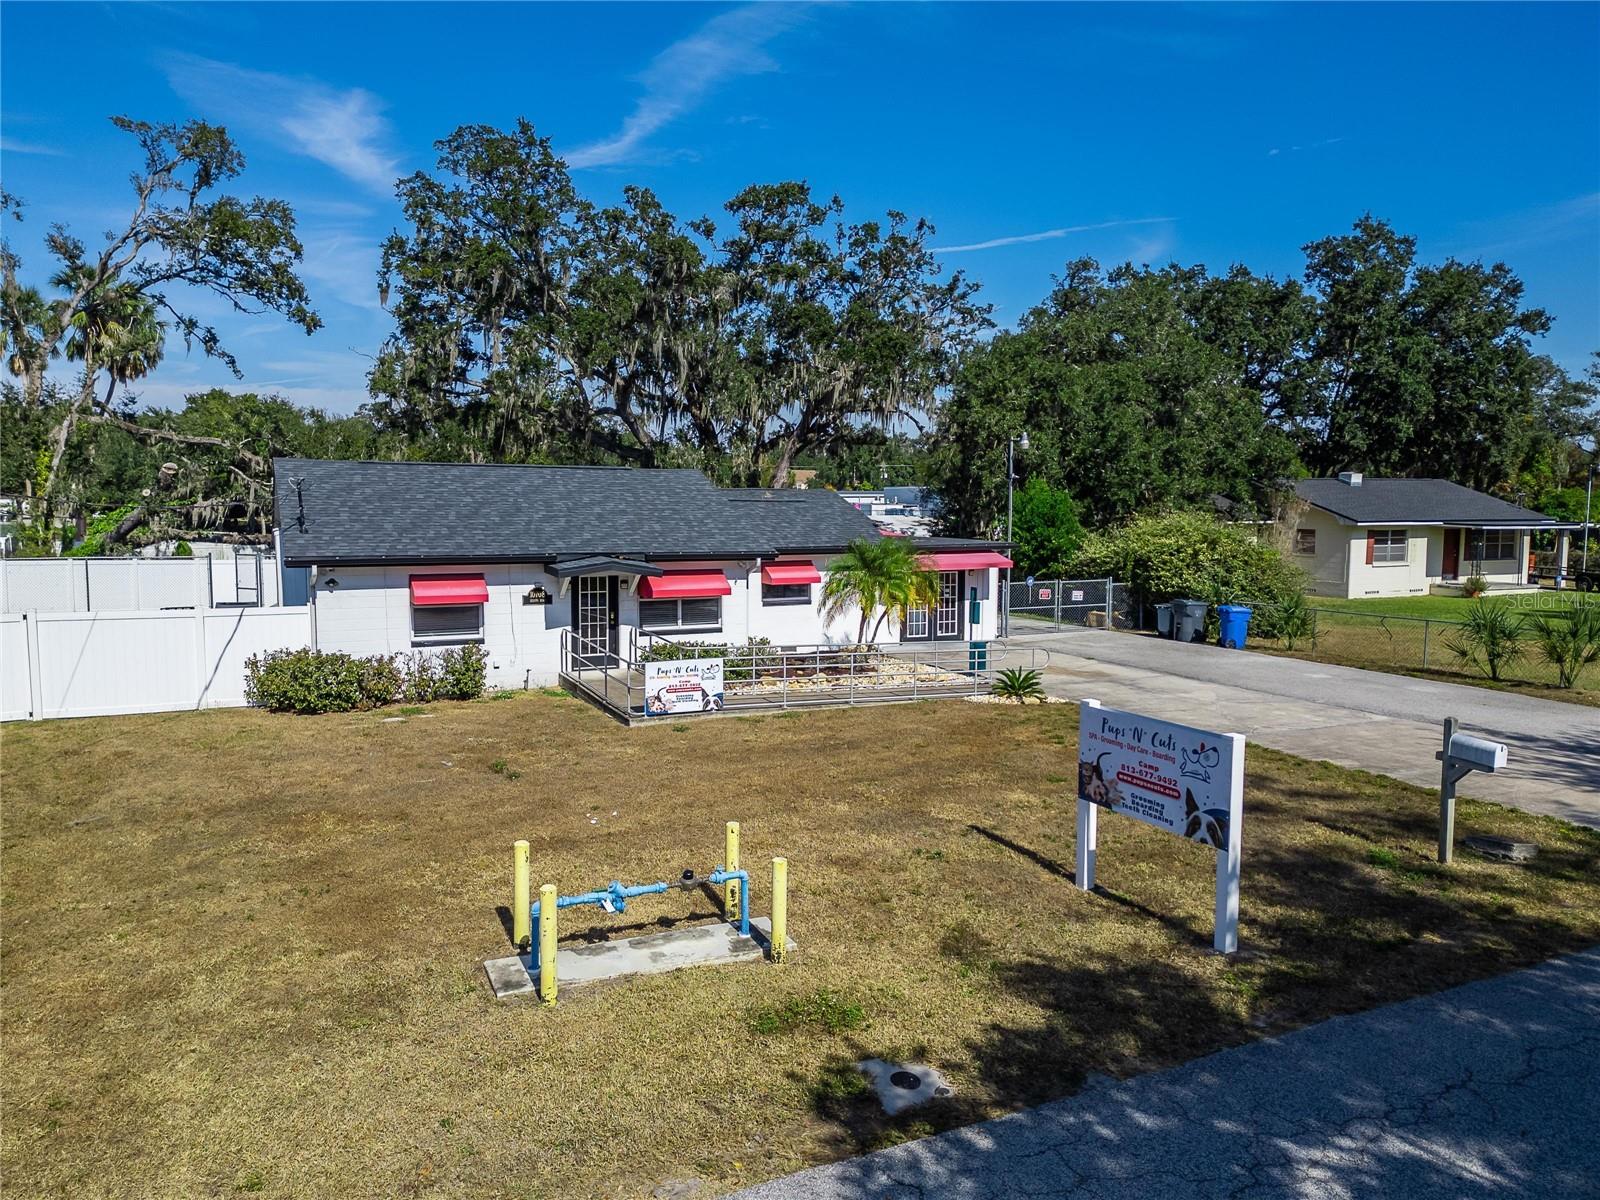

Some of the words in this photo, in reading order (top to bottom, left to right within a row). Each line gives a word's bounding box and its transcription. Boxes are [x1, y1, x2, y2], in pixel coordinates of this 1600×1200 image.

[1101, 717, 1125, 739] Pups
[1151, 732, 1176, 751] Cuts
[1088, 732, 1098, 740] SPA
[1152, 750, 1176, 765] Boarding
[1121, 764, 1178, 787] 813-677-9492
[1138, 760, 1159, 772] Camp
[1130, 793, 1165, 810] Grooming
[1131, 799, 1164, 816] Boarding
[1122, 802, 1140, 814] Teeth
[1142, 810, 1174, 826] Cleaning
